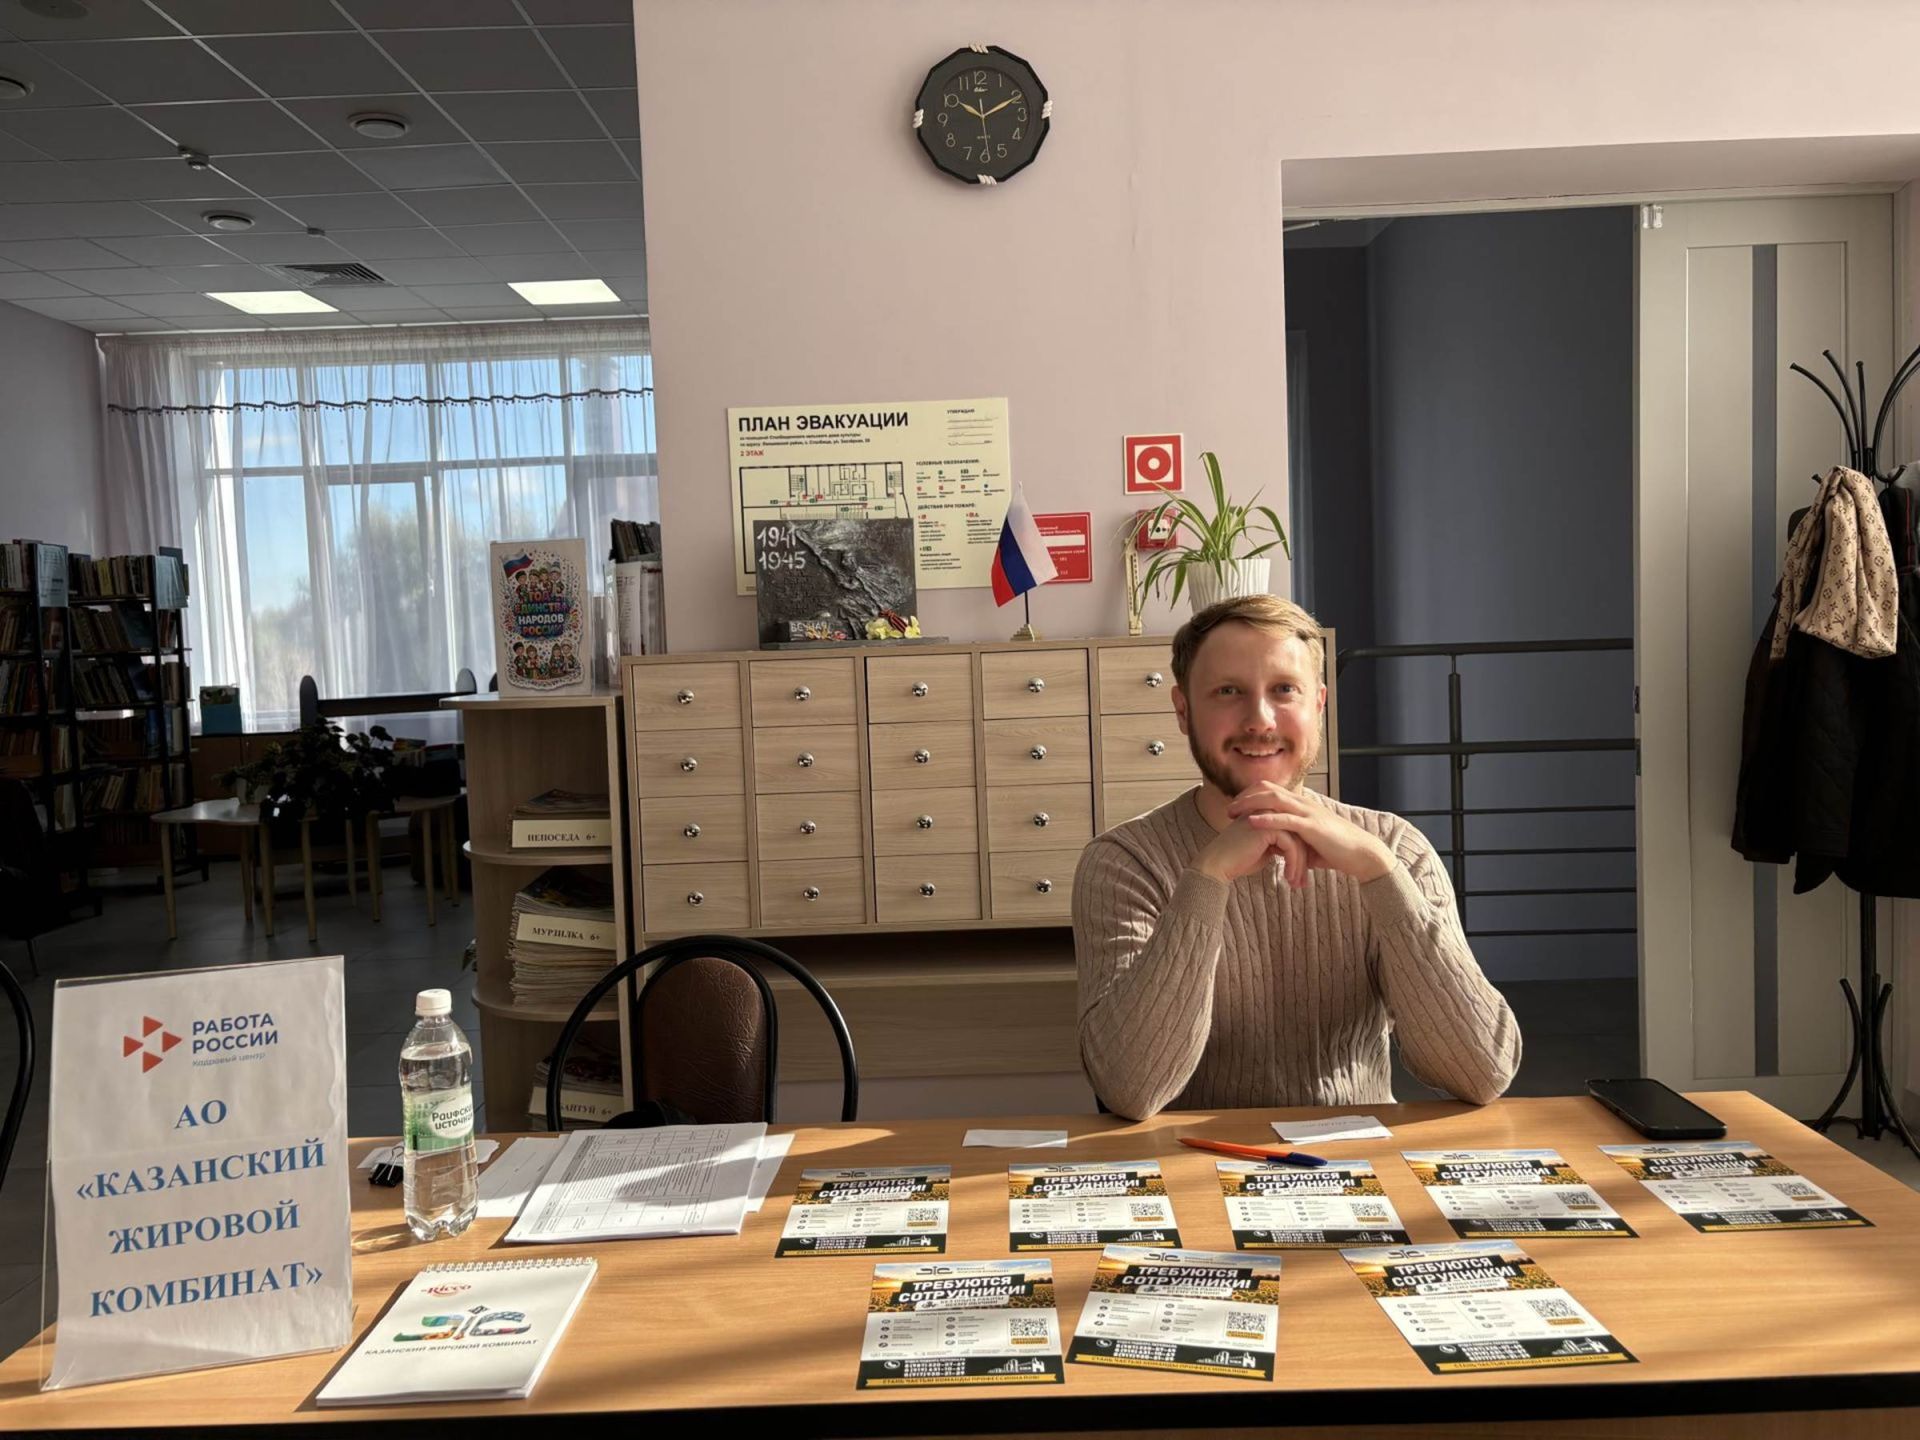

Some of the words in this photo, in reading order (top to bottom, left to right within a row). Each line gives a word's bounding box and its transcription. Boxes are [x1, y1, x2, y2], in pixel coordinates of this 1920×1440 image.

[958, 76, 969, 91] 11
[973, 70, 988, 85] 12
[943, 93, 959, 108] 10
[937, 112, 948, 127] 9
[1017, 107, 1028, 122] 3
[945, 132, 956, 148] 8
[1012, 127, 1022, 141] 4
[963, 146, 972, 161] 7
[997, 143, 1008, 158] 5
[738, 416, 790, 432] ПЛАН
[796, 411, 909, 431] ЭВАКУАЦИИ
[757, 525, 796, 549] 1941
[758, 550, 807, 570] 1945
[518, 613, 565, 625] НАРОДОВ
[527, 833, 580, 842] НЕПОСЕДА
[586, 833, 597, 841] 6+
[193, 1013, 274, 1036] РАБОТА
[193, 1030, 278, 1054] РОССИИ
[174, 1099, 227, 1129] АО
[1445, 1160, 1532, 1172] ТРЕБУЮТСЯ
[1648, 1159, 1759, 1174] СОТРУДНИКИ!
[1651, 1153, 1736, 1166] ТРЕБУЮТСЯ
[76, 1137, 327, 1200] «КАЗАНСКИЙ
[1441, 1167, 1551, 1180] СОТРУДНИКИ!
[833, 1178, 916, 1190] ТРЕБУЮТСЯ
[1043, 1172, 1127, 1184] ТРЕБУЮТСЯ
[1246, 1179, 1356, 1191] СОТРУДНИКИ!
[1254, 1172, 1341, 1183] ТРЕБУЮТСЯ
[819, 1184, 927, 1198] СОТРУДНИКИ!
[1033, 1179, 1140, 1193] СОТРУДНИКИ!
[108, 1199, 301, 1255] ЖИРОВОЙ
[1138, 1266, 1239, 1278] ТРЕБУЮТСЯ
[1394, 1257, 1493, 1275] ТРЕБУЮТСЯ
[913, 1276, 1012, 1291] ТРЕБУЮТСЯ
[1121, 1275, 1251, 1289] СОТРУДНИКИ!
[1391, 1265, 1517, 1287] СОТРУДНИКИ!
[90, 1262, 323, 1318] КОМБИНАТ»
[899, 1284, 1026, 1303] СОТРУДНИКИ!
